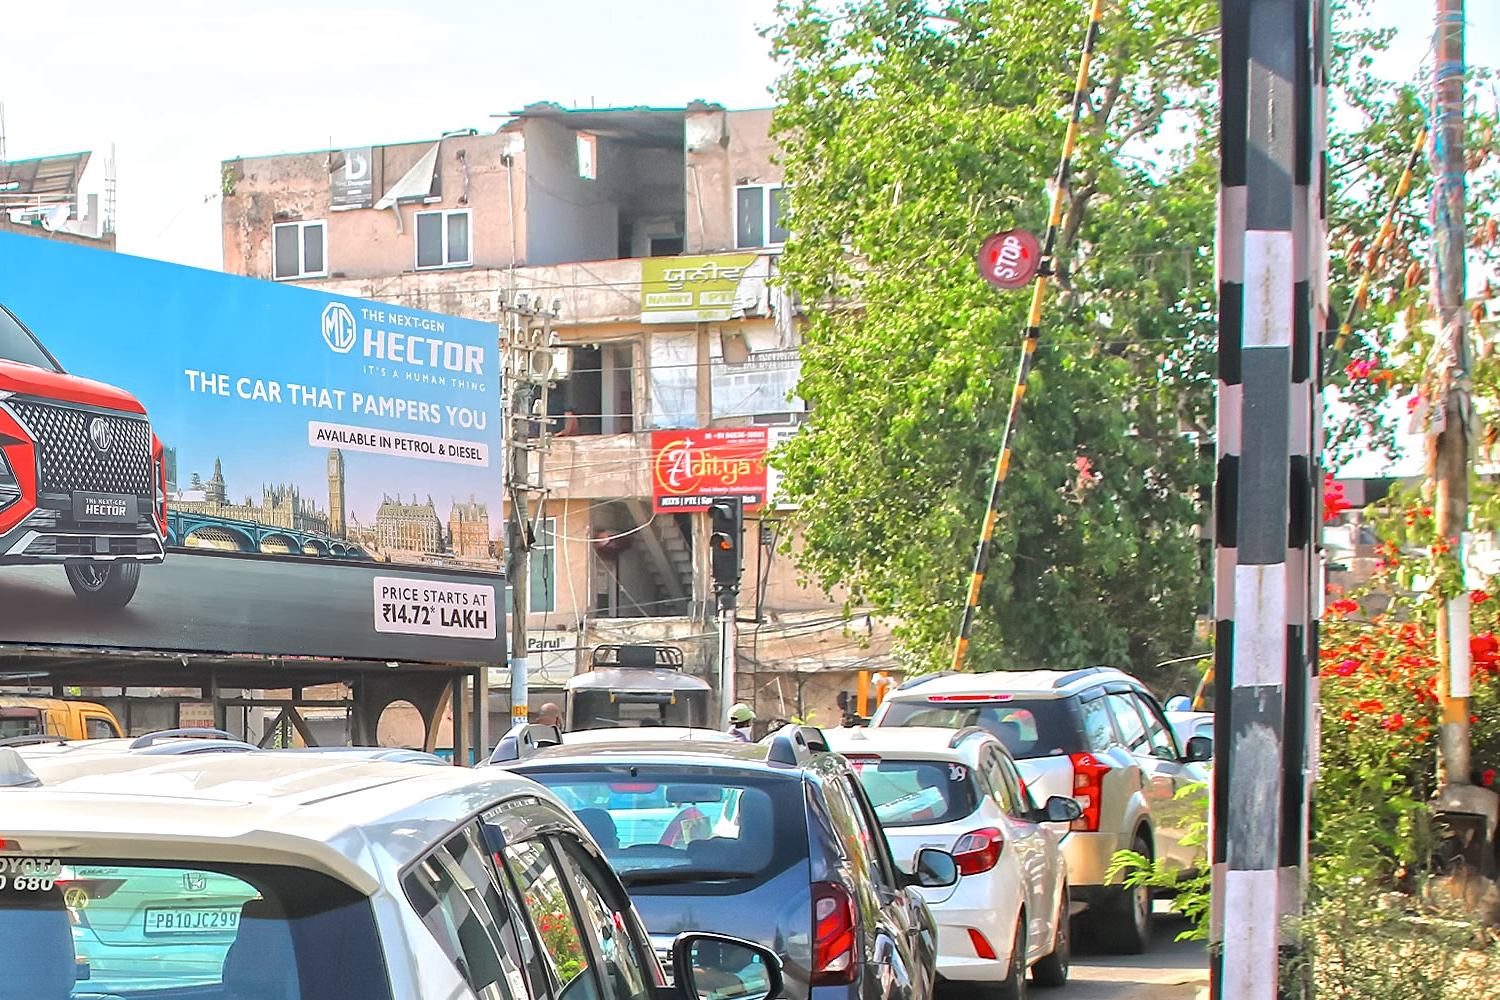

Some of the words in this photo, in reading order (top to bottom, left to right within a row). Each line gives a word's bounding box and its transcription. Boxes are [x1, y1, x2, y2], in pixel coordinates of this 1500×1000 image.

[994, 236, 1022, 279] STOP
[361, 308, 385, 323] THE
[388, 313, 445, 333] NEXT-GEN
[363, 328, 484, 375] HECTOR
[363, 364, 386, 377] IT'S
[392, 370, 399, 379] A
[405, 371, 446, 386] HUMAN
[451, 378, 486, 393] THING
[185, 369, 231, 397] THE
[236, 377, 282, 404] CAR
[286, 383, 346, 412] THAT
[351, 392, 441, 424] PAMPERS
[444, 405, 487, 431] YOU
[316, 428, 377, 448] AVAILABLE
[379, 435, 392, 449] IN
[394, 437, 436, 455] PETROL
[438, 443, 446, 455] &
[448, 444, 483, 461] DIESEL
[85, 505, 126, 516] HECTOR
[382, 586, 419, 601] PRICE
[423, 590, 469, 606] STARTS
[472, 594, 488, 607] AT
[440, 607, 488, 630] LAKH
[13, 875, 54, 891] 680
